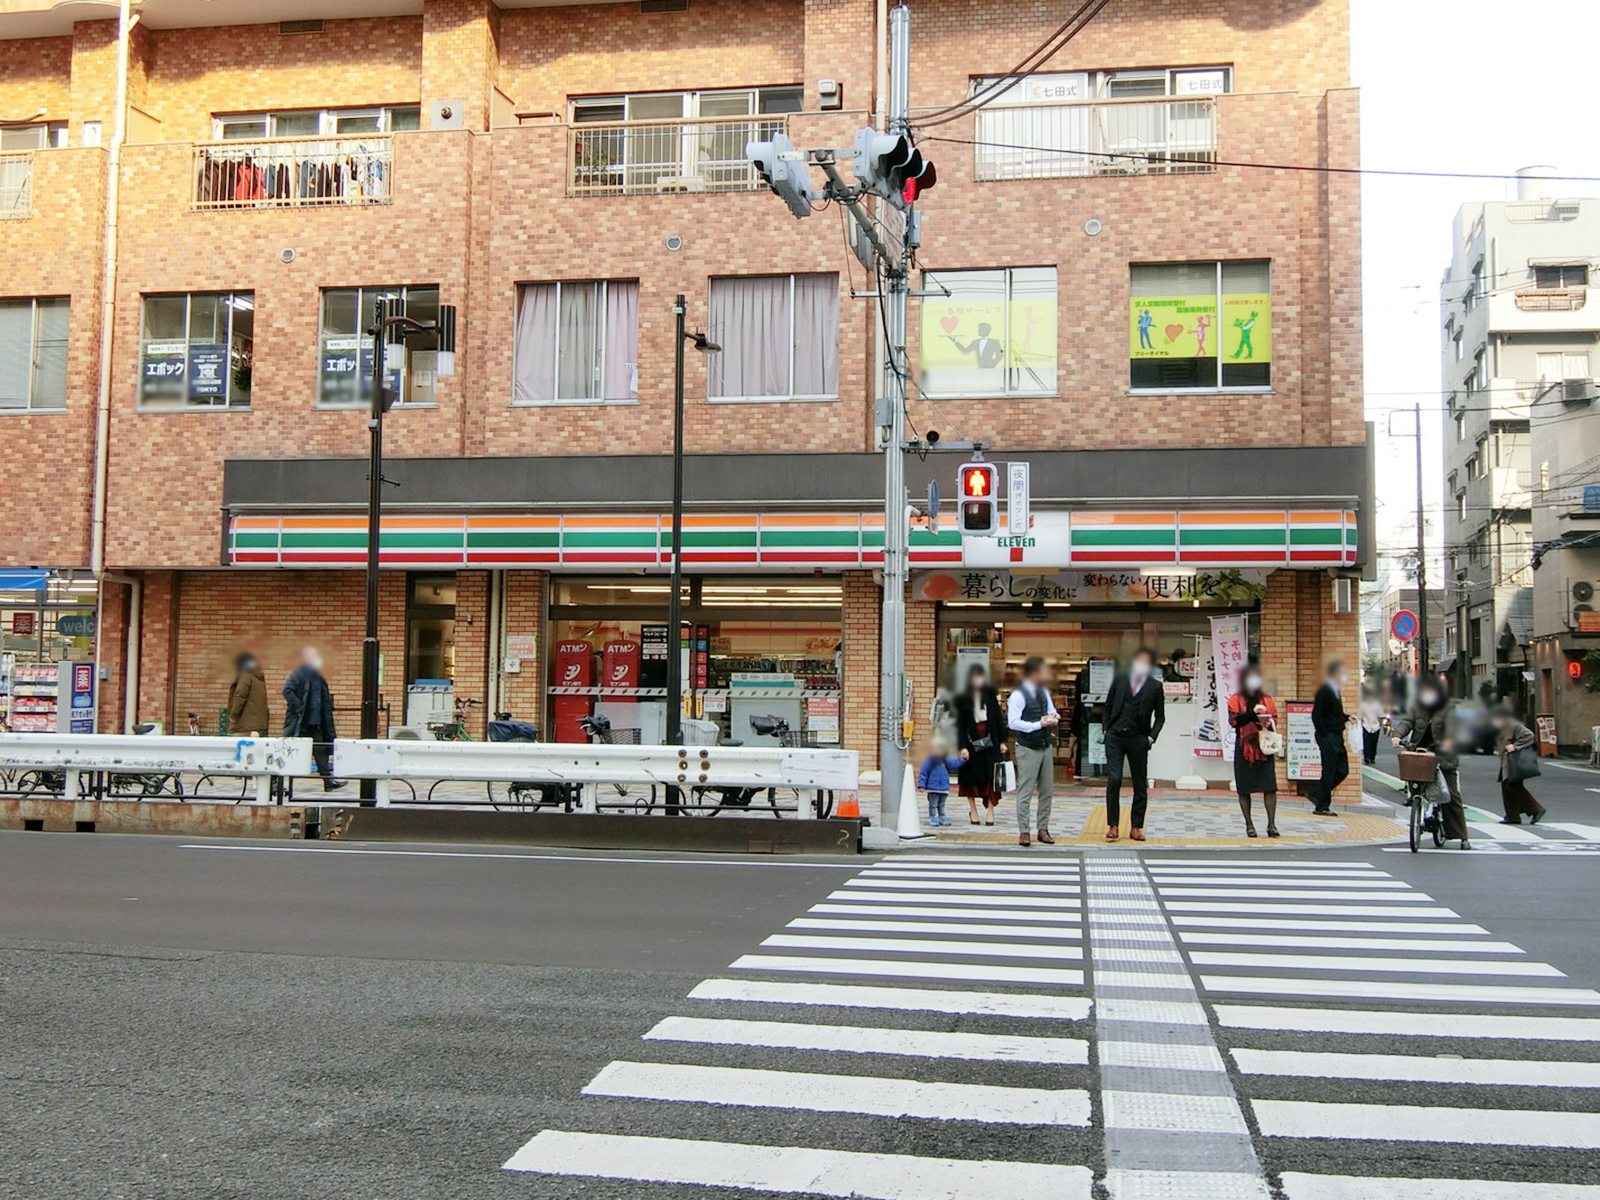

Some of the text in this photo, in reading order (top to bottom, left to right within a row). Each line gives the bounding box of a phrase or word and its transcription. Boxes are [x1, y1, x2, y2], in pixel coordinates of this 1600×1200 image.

[1043, 85, 1077, 97] 七田式
[1187, 78, 1223, 91] 七田式
[146, 362, 184, 375] エポック
[326, 358, 357, 371] エポッ
[961, 573, 1219, 599] 暮らしの変化に 変わらない便利を
[560, 645, 581, 653] ATM
[607, 645, 629, 653] ATM
